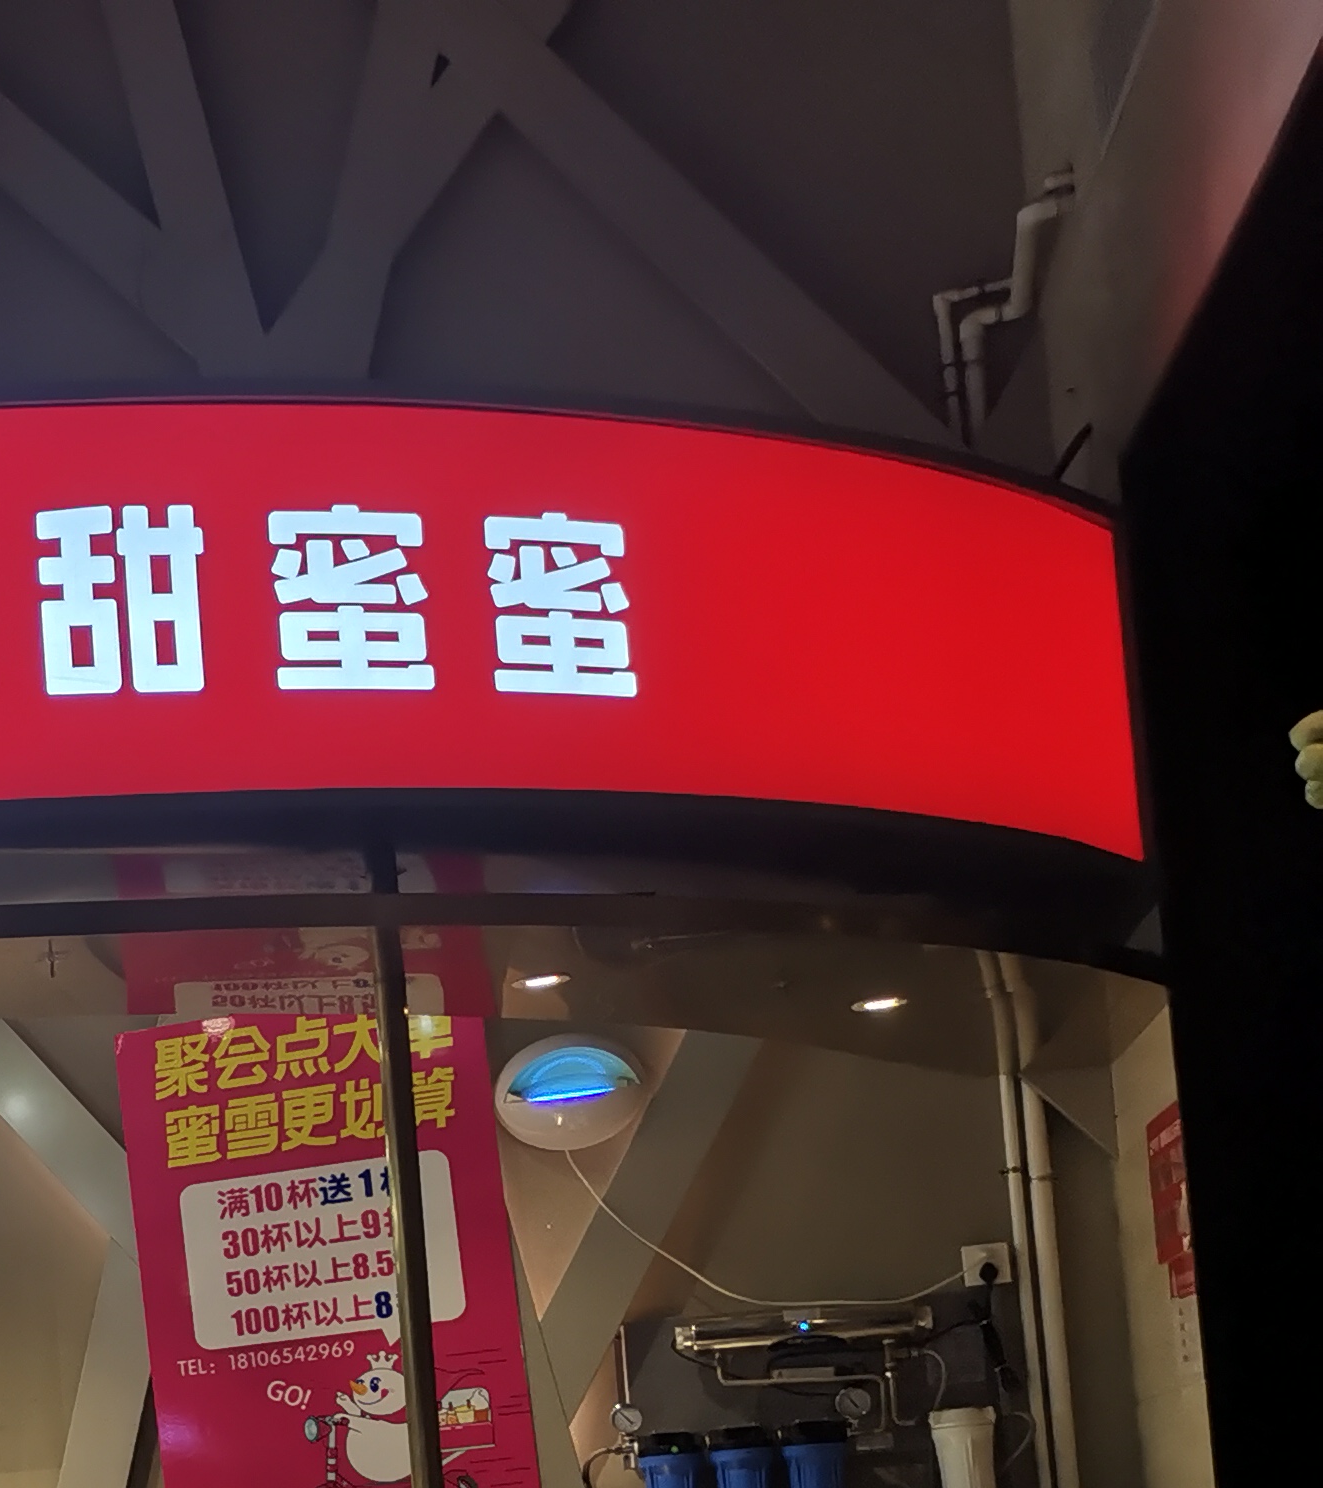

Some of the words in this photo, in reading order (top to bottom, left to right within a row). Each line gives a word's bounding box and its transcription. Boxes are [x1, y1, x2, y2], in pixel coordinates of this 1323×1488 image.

[217, 1165, 391, 1220] 满10杯送1
[225, 1249, 395, 1297] 50杯以上8.5
[230, 1290, 399, 1337] 100杯以上8
[228, 1339, 355, 1371] 18106542969
[266, 1379, 312, 1411] GO!
